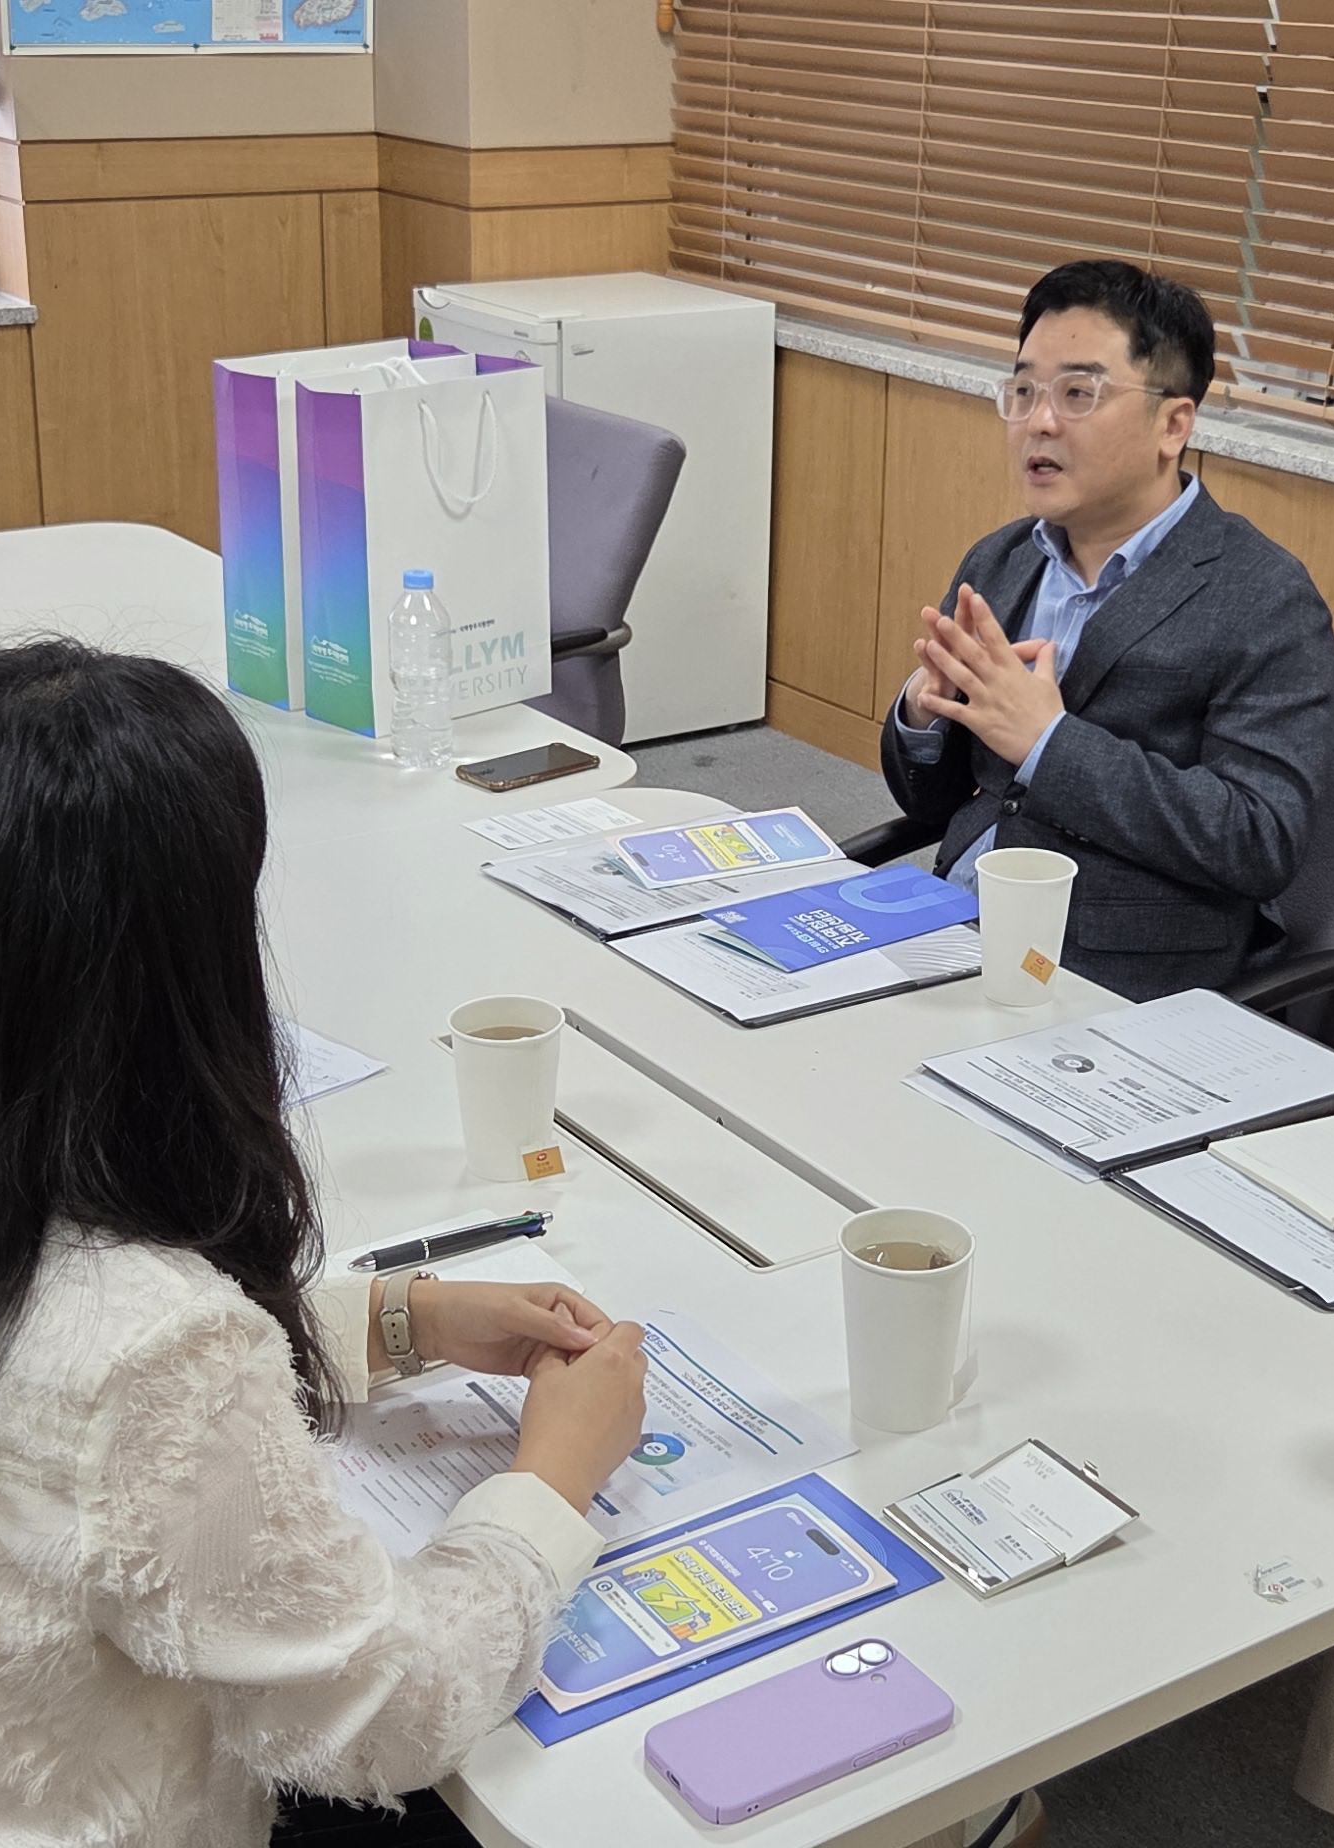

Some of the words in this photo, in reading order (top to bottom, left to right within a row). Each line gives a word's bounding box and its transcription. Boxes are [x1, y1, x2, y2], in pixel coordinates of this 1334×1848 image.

[452, 664, 527, 700] ERSITY
[809, 909, 870, 943] 지원센터
[747, 1547, 793, 1581] 4:10
